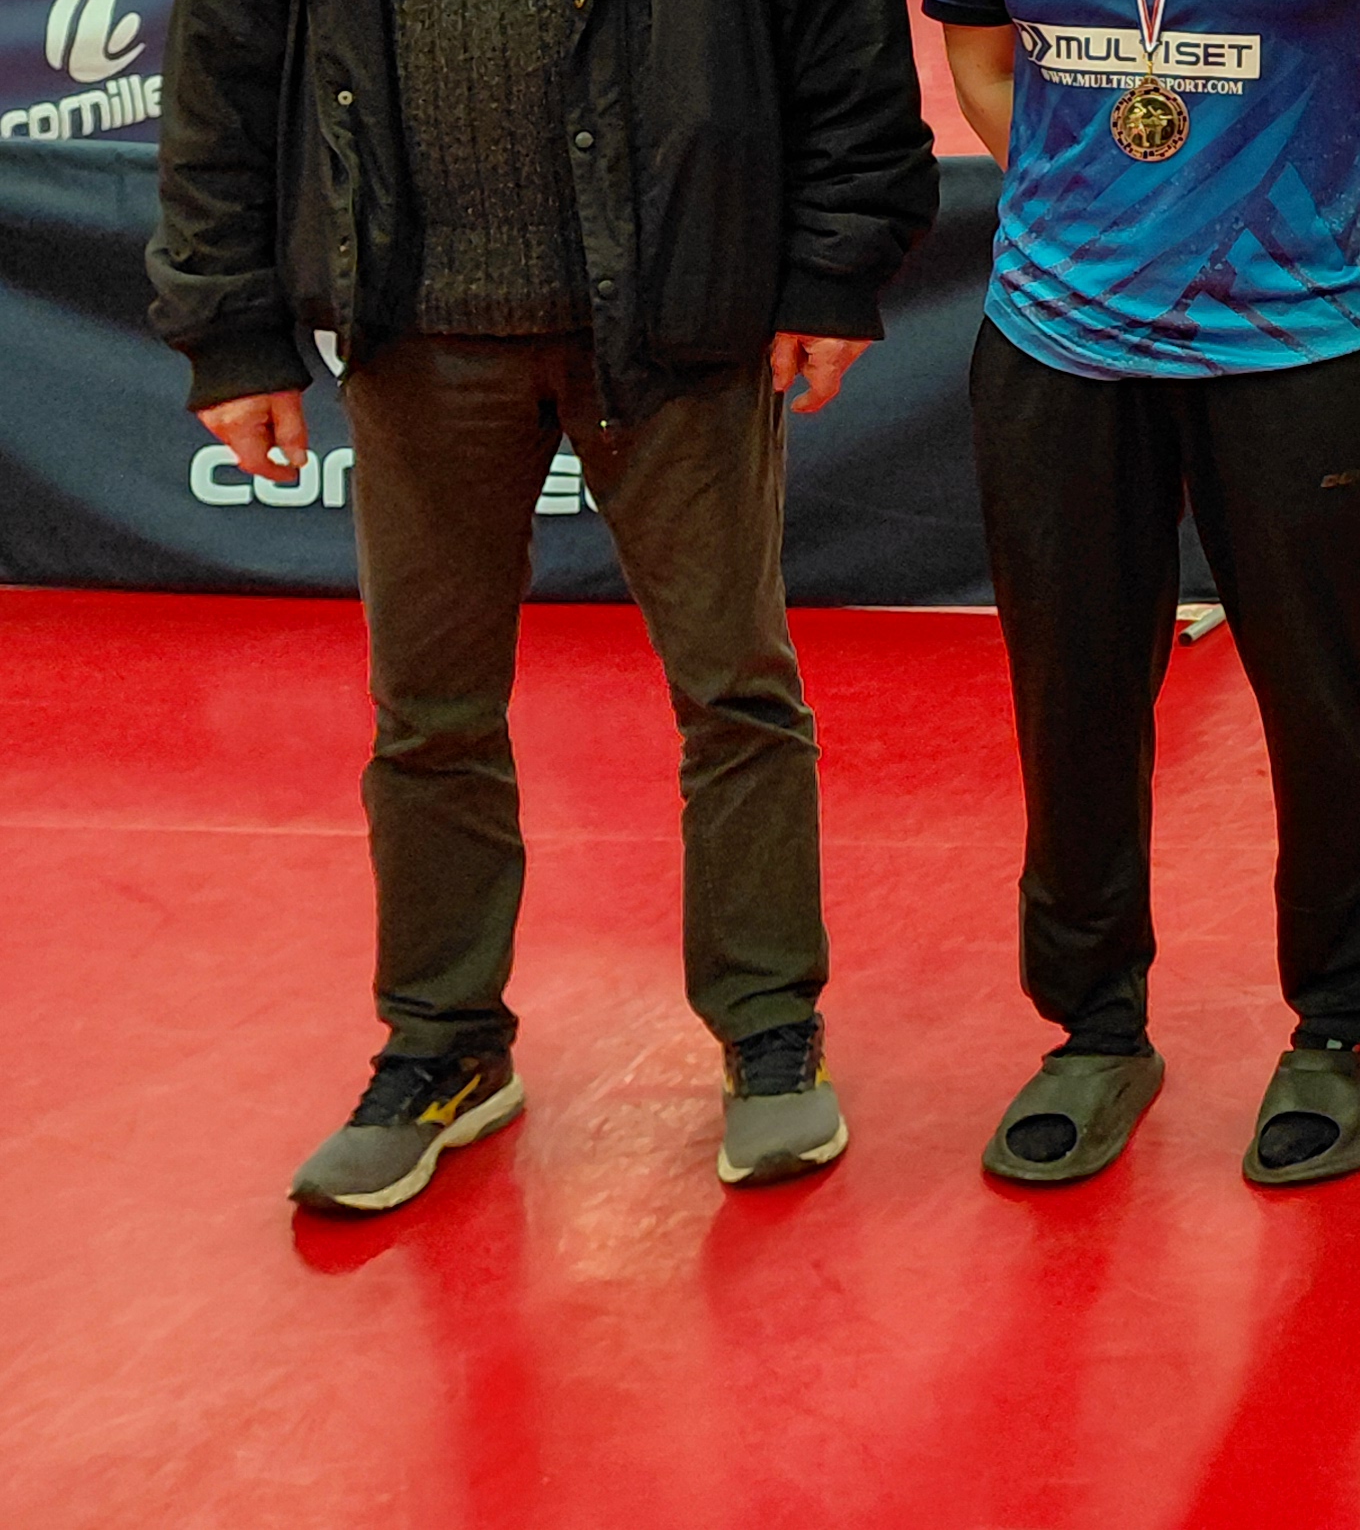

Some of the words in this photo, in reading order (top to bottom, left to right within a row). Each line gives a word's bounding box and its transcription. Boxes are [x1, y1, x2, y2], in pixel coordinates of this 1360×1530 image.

[1055, 35, 1253, 69] MULISET
[1041, 68, 1244, 95] WWW.MULTISESPORT.COM
[0, 73, 163, 141] cornille
